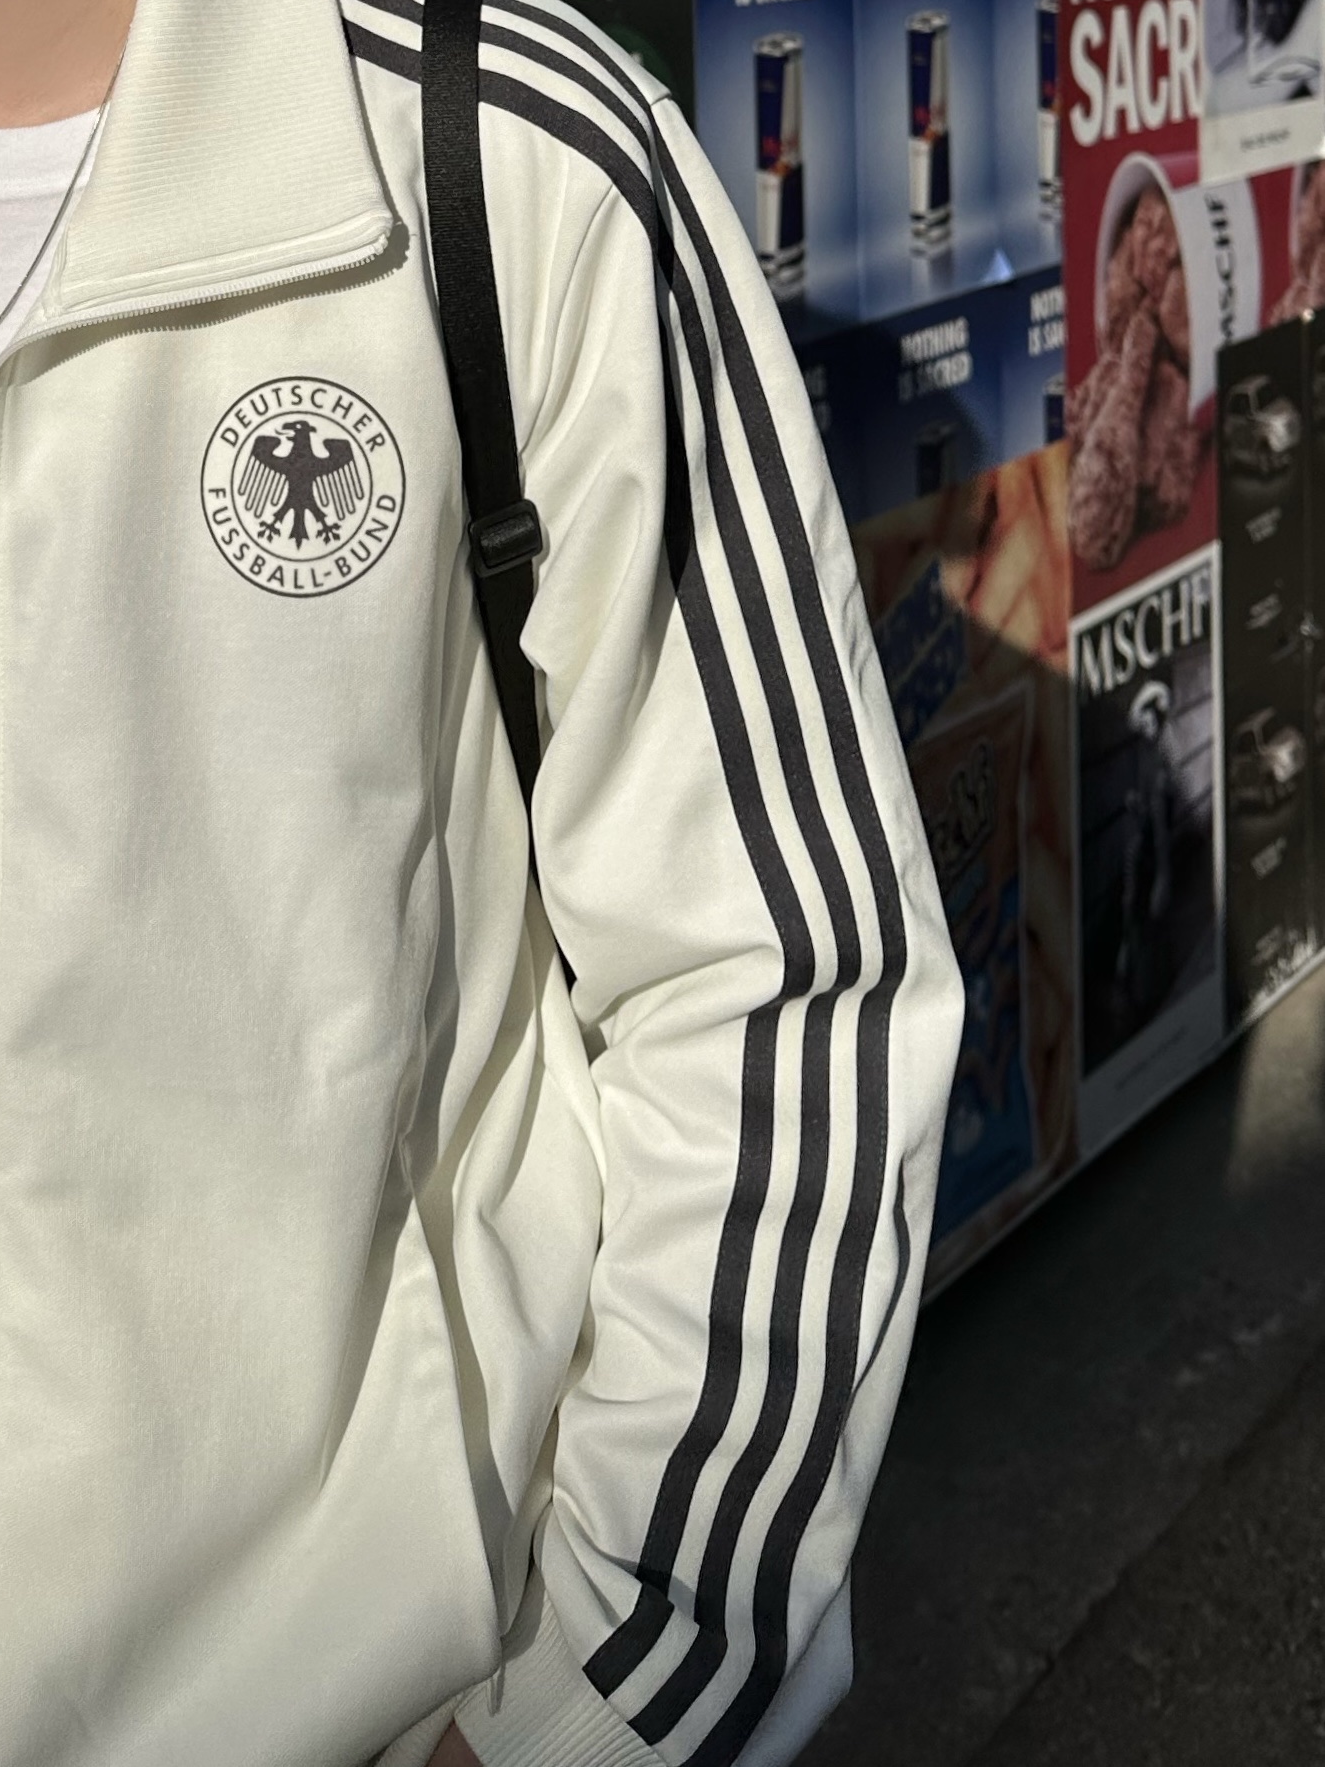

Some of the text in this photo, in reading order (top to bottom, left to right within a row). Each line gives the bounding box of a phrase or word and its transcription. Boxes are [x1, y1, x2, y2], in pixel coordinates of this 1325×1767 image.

[900, 316, 969, 367] NOTHING
[1028, 325, 1041, 358] IS
[220, 384, 386, 453] DEUTSCHER
[208, 487, 397, 590] FUSSBALL-BUND
[1081, 566, 1211, 696] MSCHF
